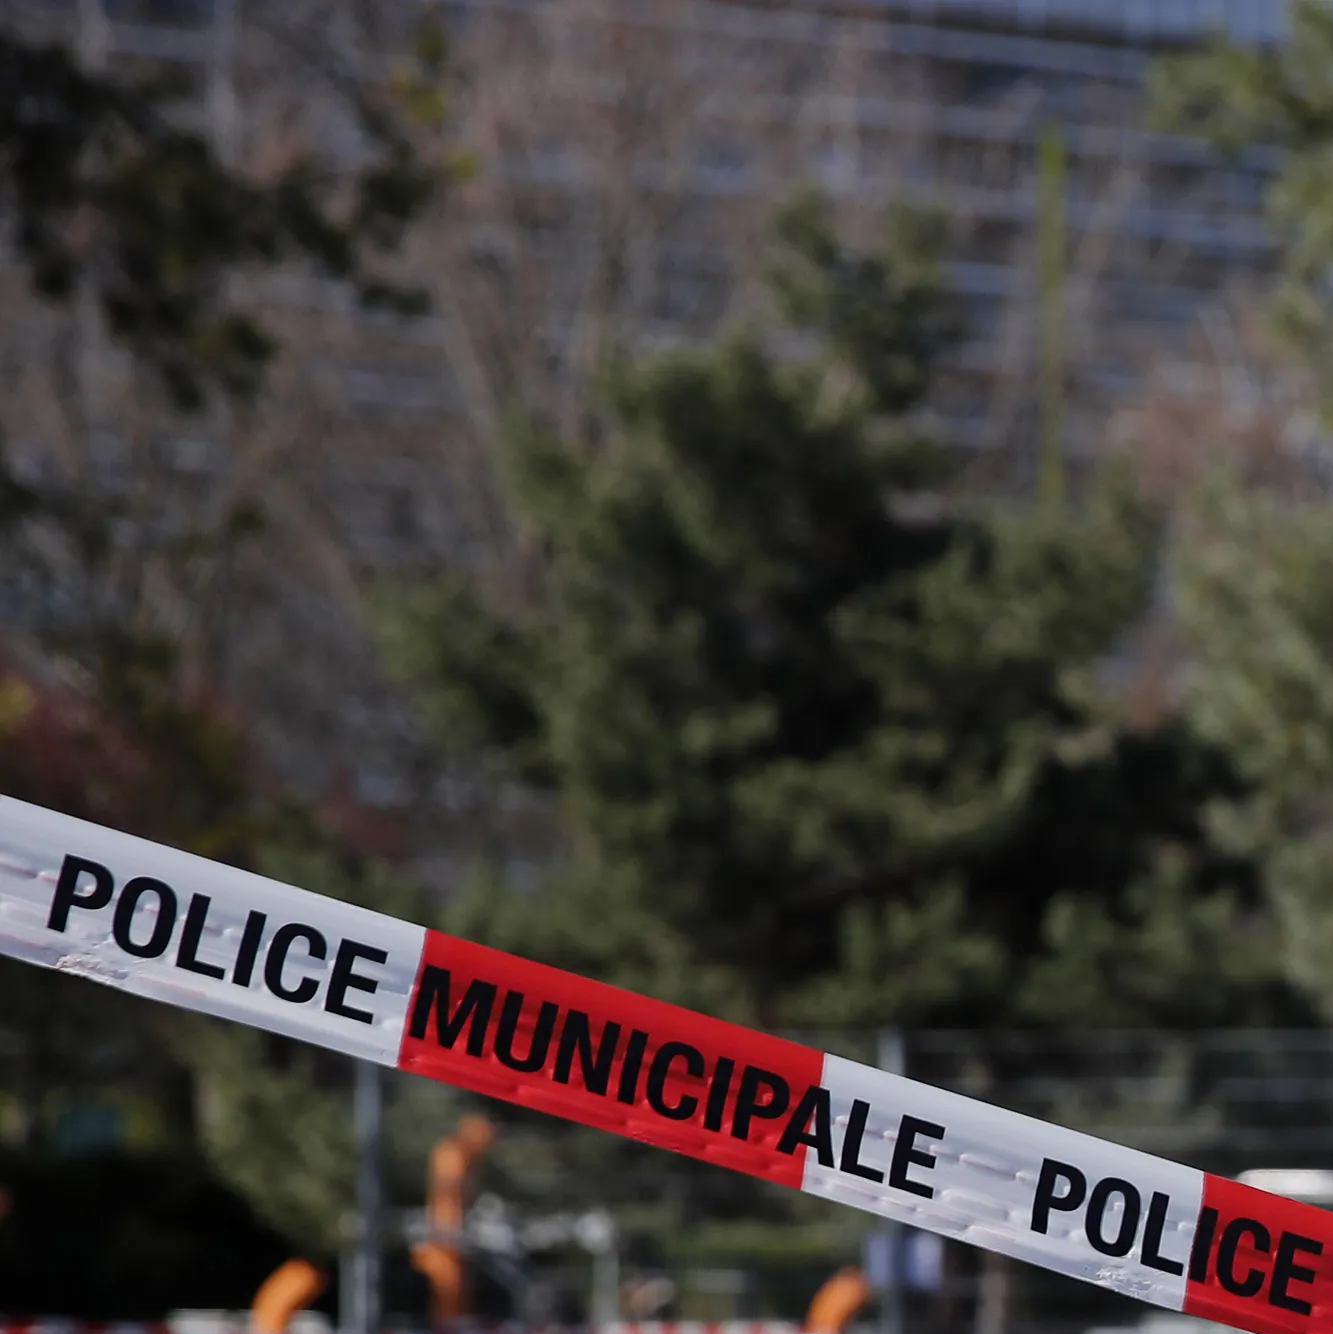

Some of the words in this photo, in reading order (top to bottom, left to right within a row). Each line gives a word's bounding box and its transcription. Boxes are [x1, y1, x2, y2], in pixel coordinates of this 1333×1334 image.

[47, 854, 388, 1024] POLICE
[409, 965, 945, 1198] MUNICIPALE
[1030, 1157, 1323, 1316] POLICE
